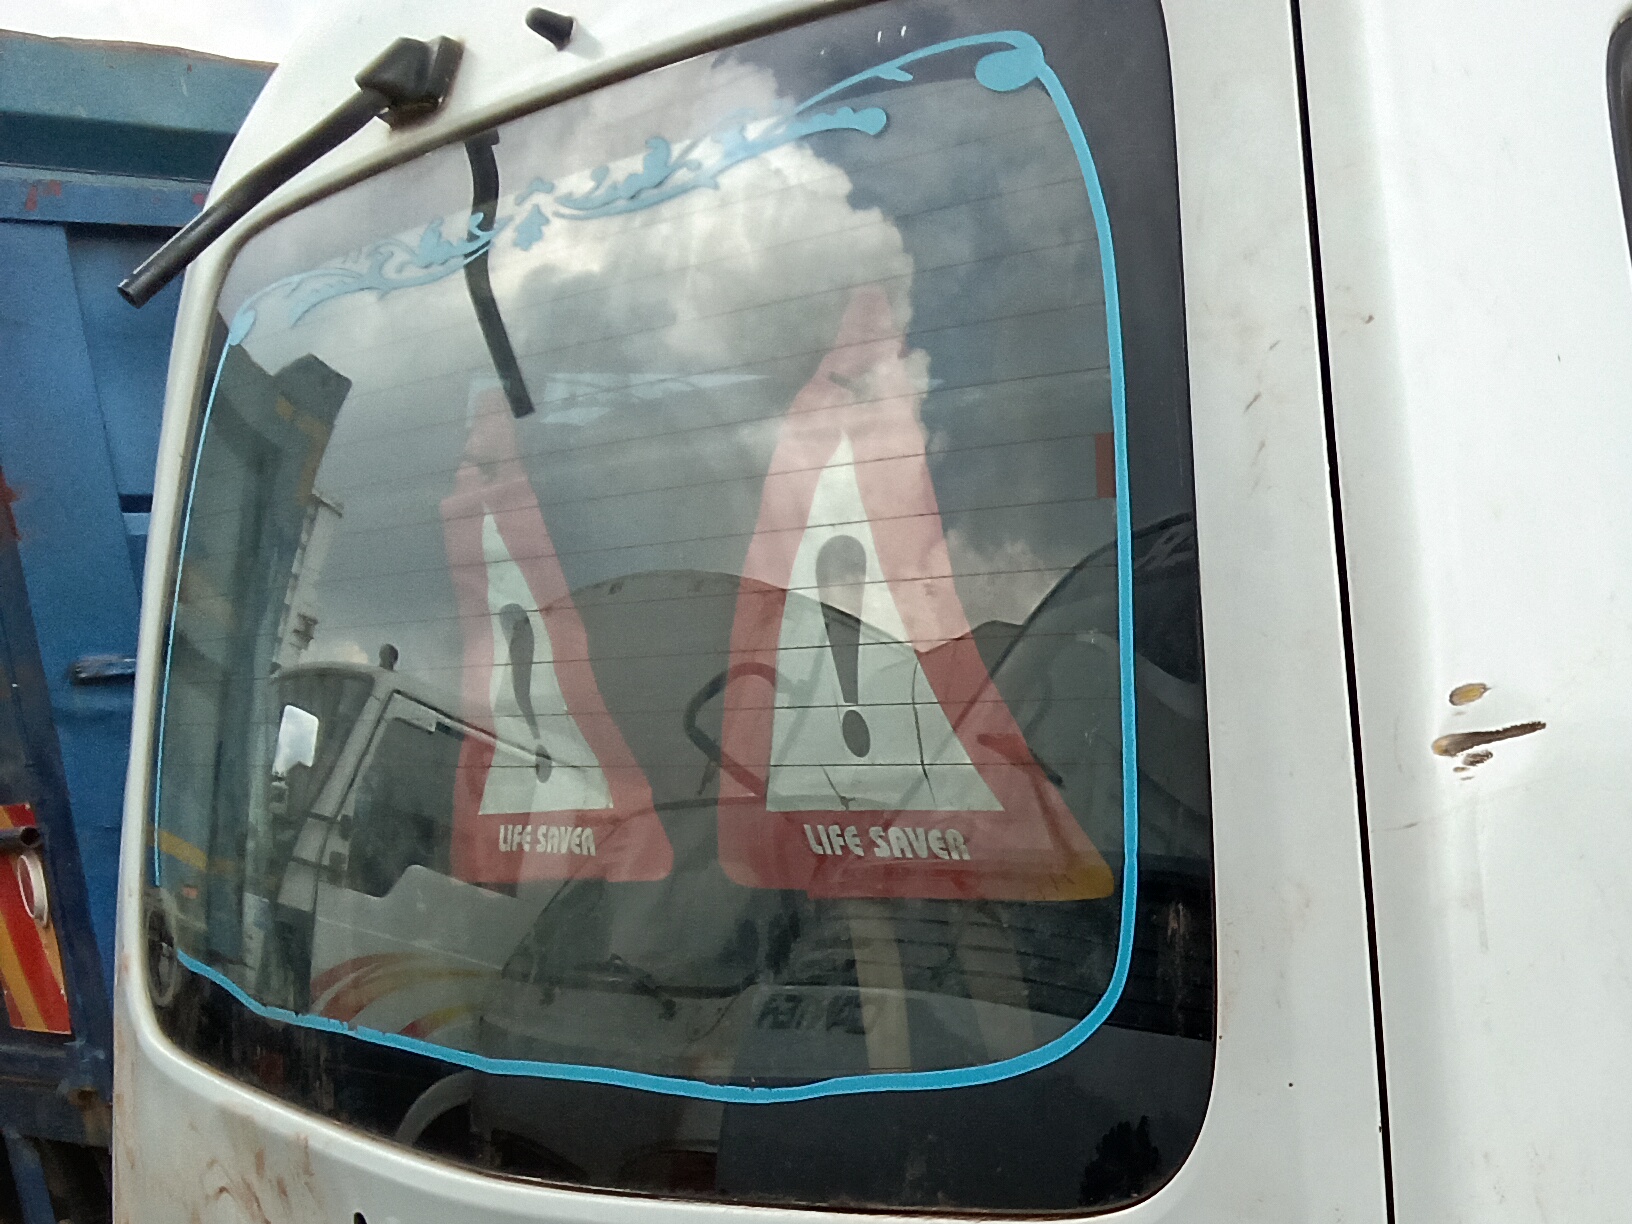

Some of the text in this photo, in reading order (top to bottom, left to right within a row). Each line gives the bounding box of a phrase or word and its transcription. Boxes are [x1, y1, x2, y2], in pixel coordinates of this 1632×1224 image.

[499, 825, 596, 856] LIFE SAVER
[803, 824, 970, 860] LIFE SAVER
